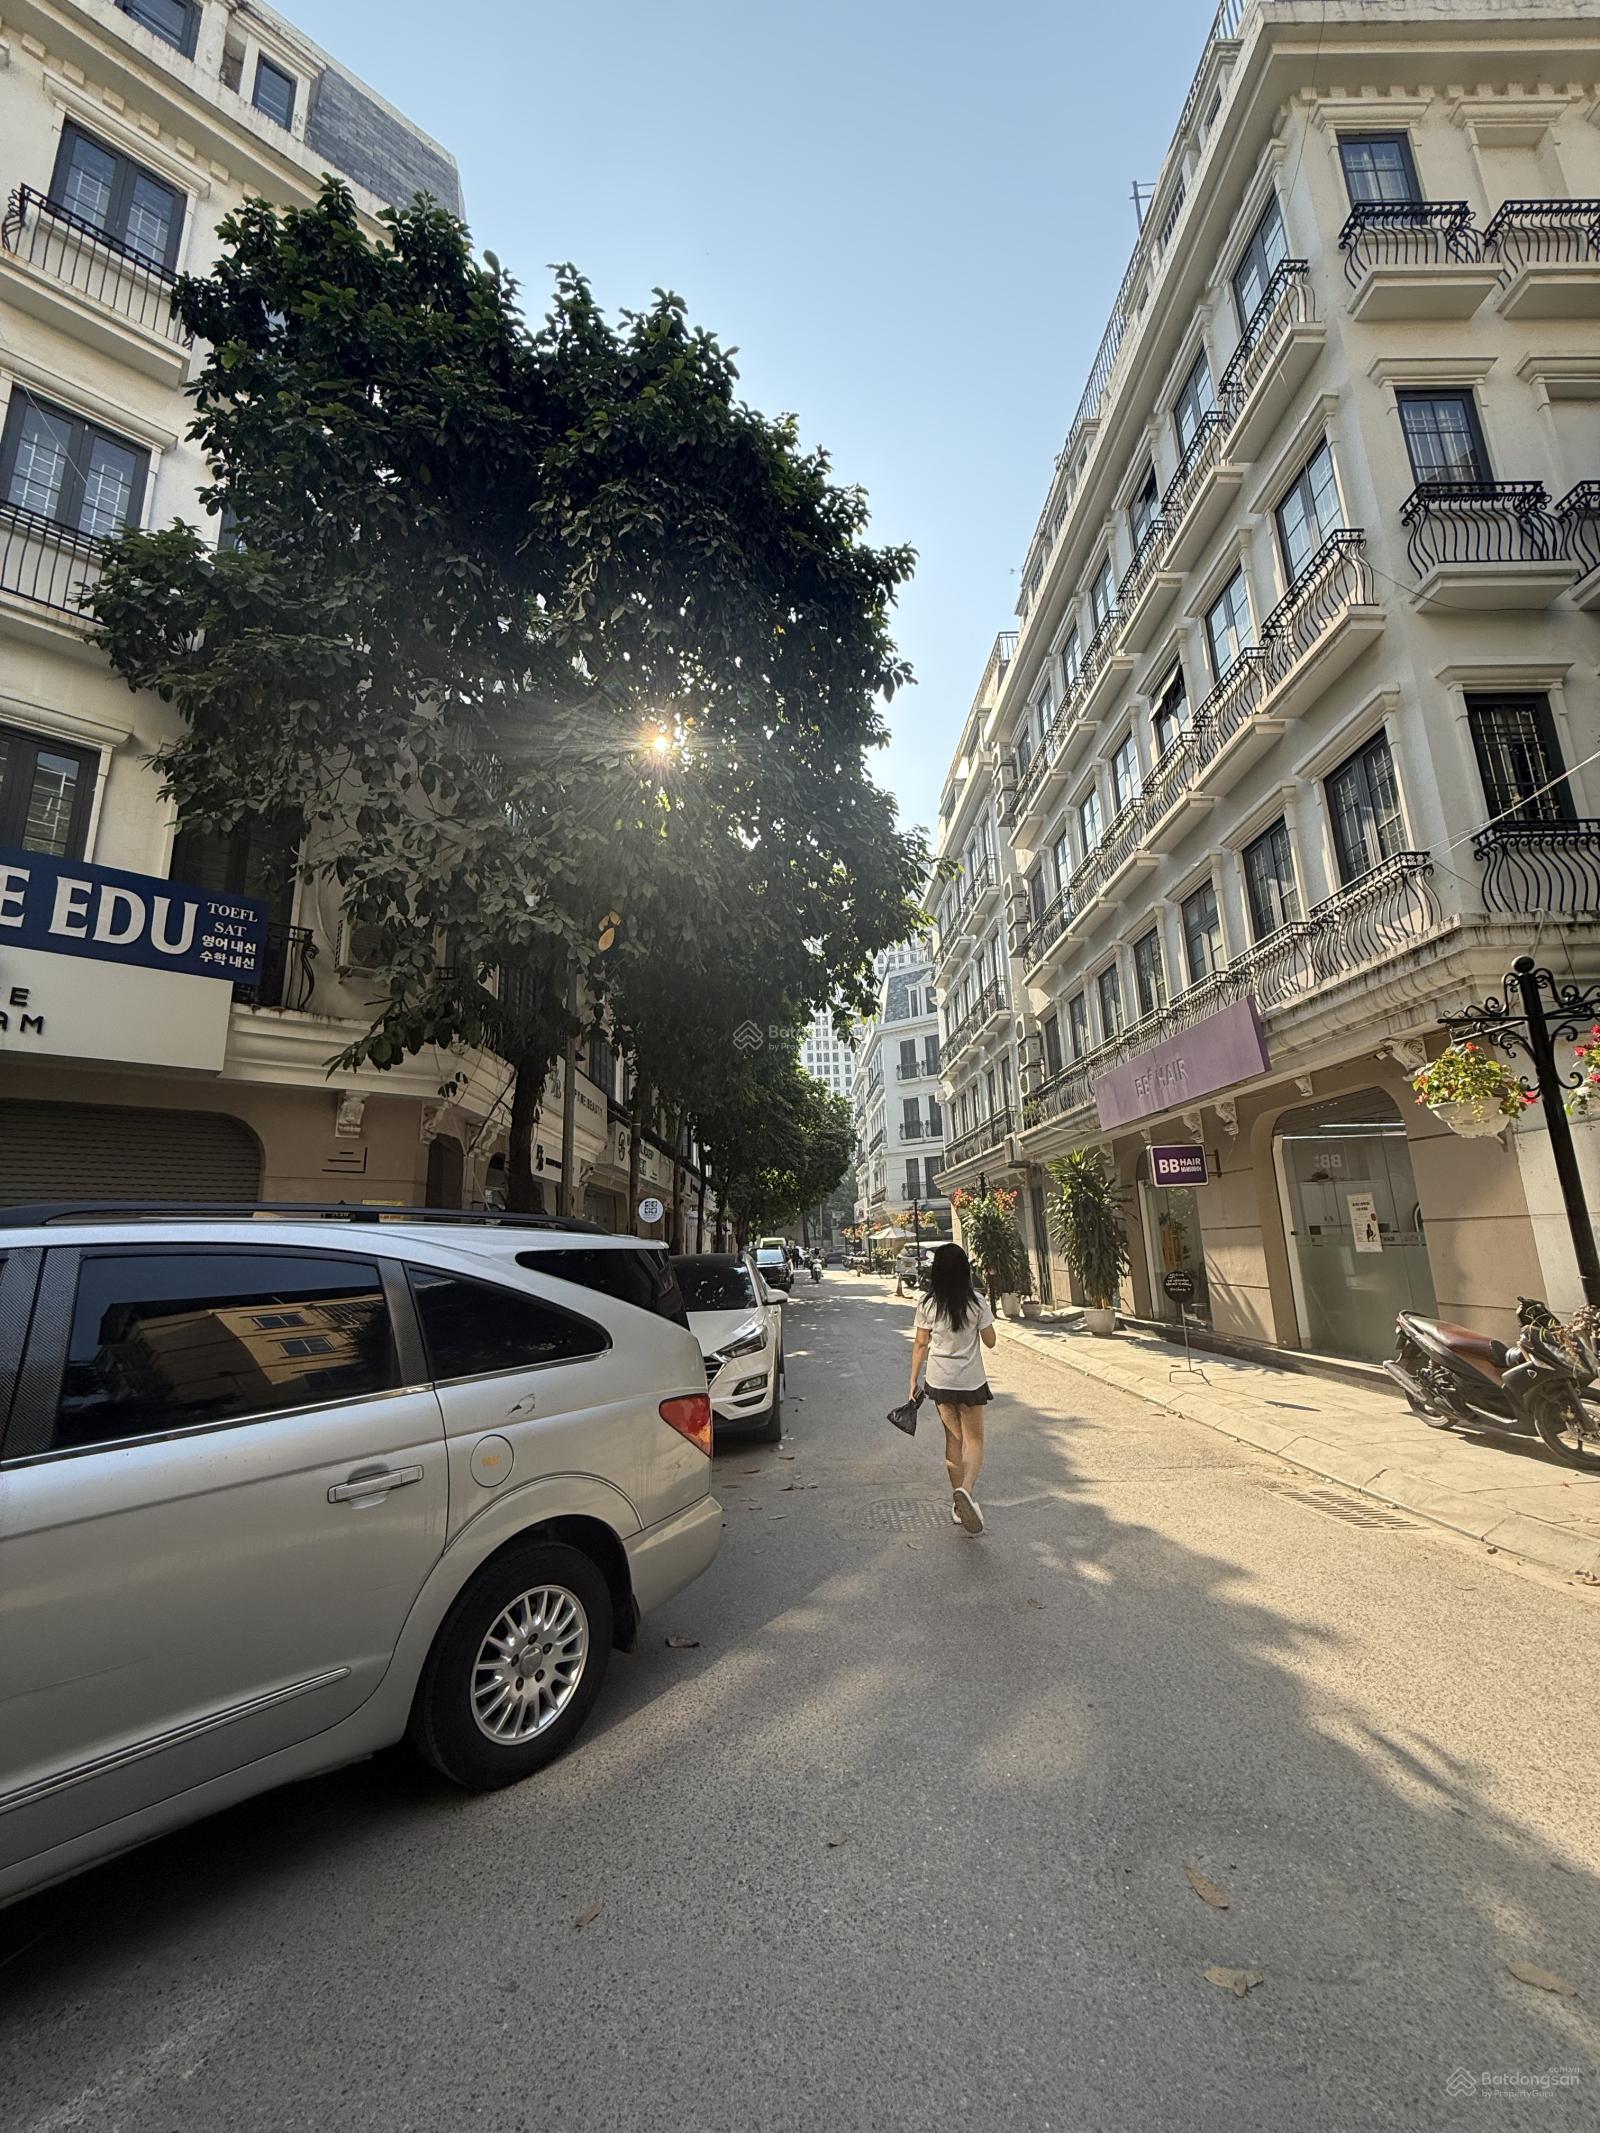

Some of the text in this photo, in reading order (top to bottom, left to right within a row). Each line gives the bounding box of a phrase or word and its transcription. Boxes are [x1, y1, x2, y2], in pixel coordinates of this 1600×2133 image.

[48, 875, 199, 955] EDU
[207, 902, 258, 922] TOEFL
[214, 921, 247, 937] SAT
[202, 935, 257, 955] 영어 내신
[200, 950, 255, 970] 수학 내신
[1155, 1058, 1189, 1088] HAIR
[1159, 1158, 1180, 1174] BB
[1180, 1158, 1201, 1166] HAIR
